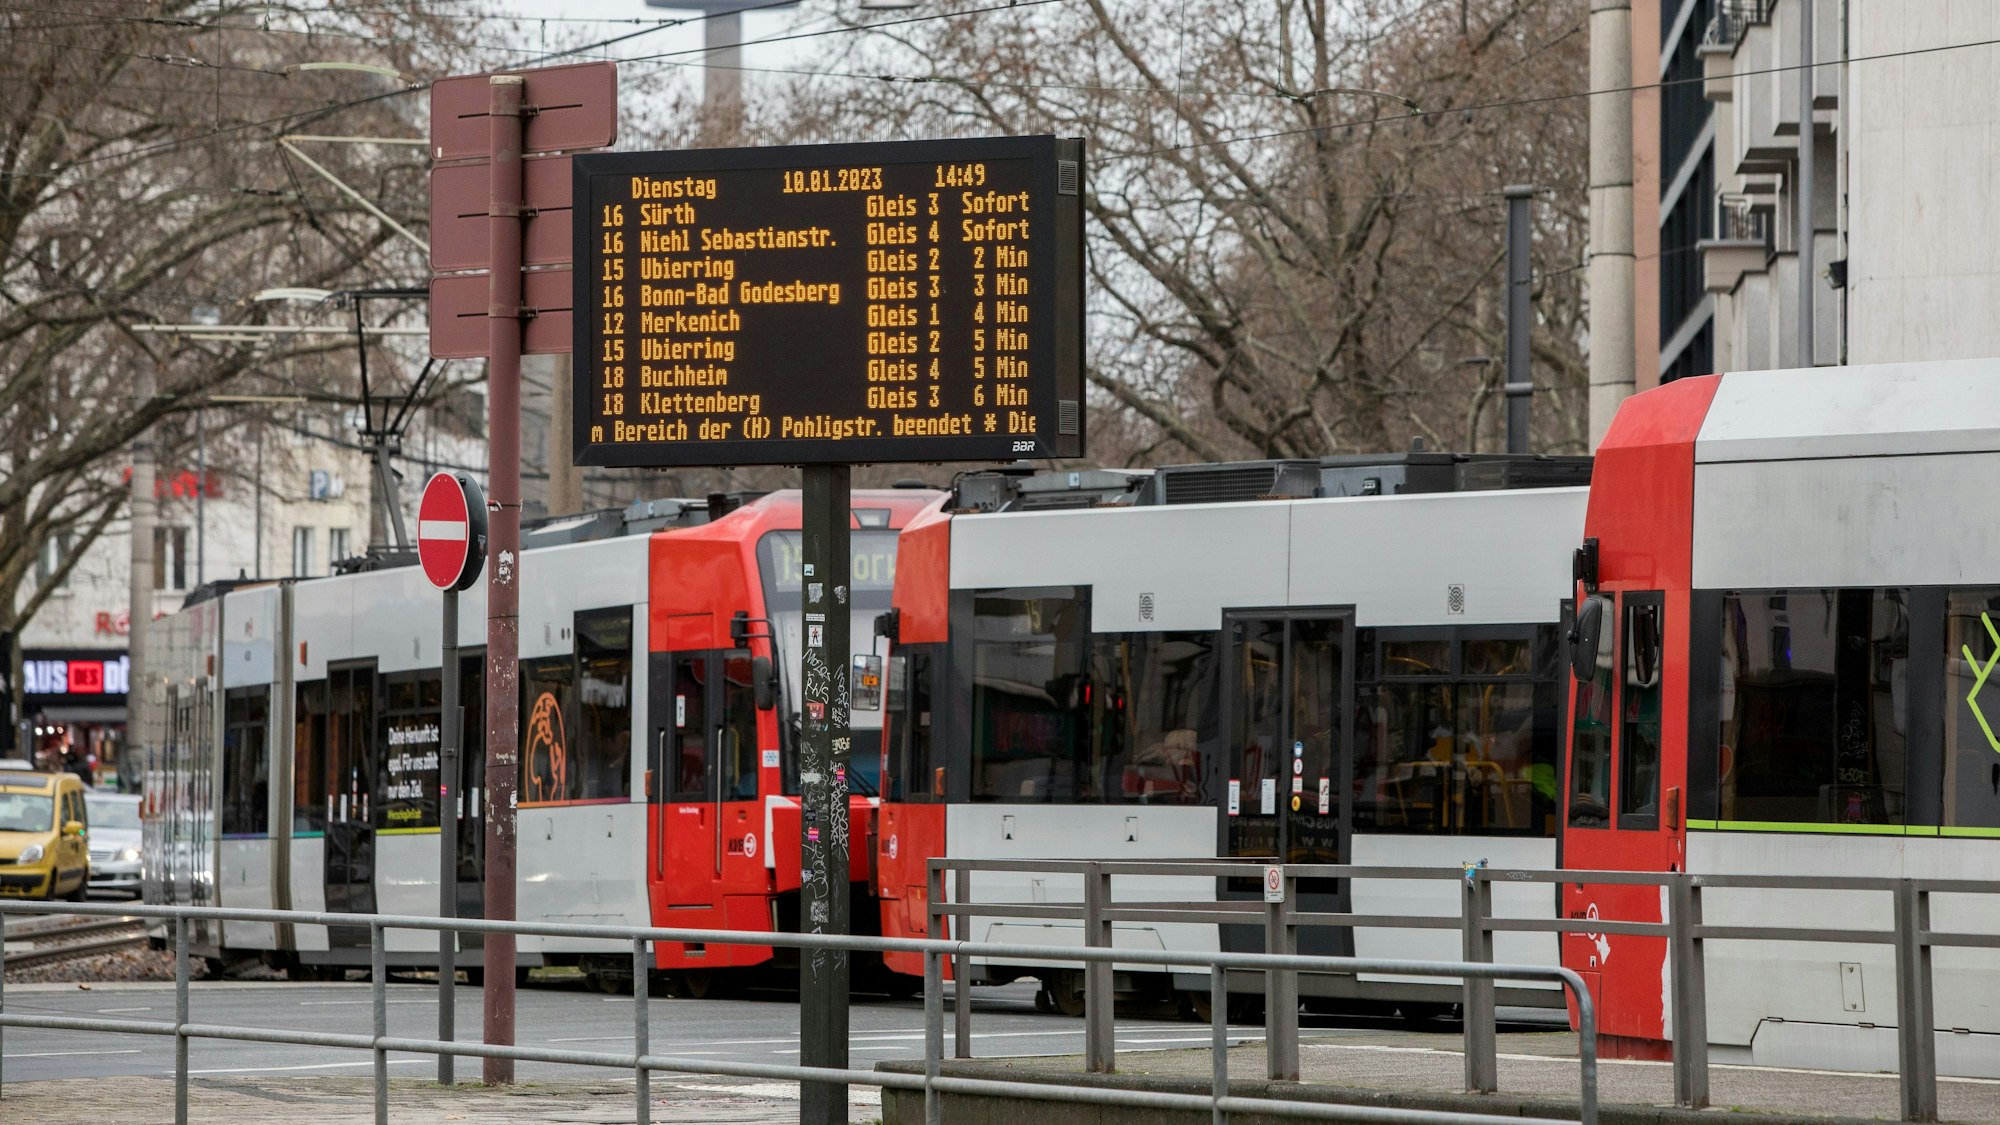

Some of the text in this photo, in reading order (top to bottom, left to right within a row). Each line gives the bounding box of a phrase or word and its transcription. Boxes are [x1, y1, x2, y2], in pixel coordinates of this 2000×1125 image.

[632, 164, 985, 199] Dienstag 10.01.2023 14:49
[603, 191, 1029, 226] 16 Sürth Gleis 3 Sofort
[603, 219, 1029, 253] 16 Niehl Sebastianstr. Gleis 4 Sofort
[603, 246, 1027, 281] 15 Ubierring Gleis 2 2 Min
[603, 273, 1027, 307] 16 Bonn-Bad Godesberg Gleis 3 3 Min
[603, 301, 1027, 334] 12 Merkenich Gleis 1 4 Min
[603, 329, 1027, 361] 15 Ubierring Gleis 2 5 Min
[603, 356, 1027, 388] 18 Buchheim Gleis 4 5 Min
[603, 384, 1027, 415] 18 Klettenberg Gleis 3 6 Min
[615, 419, 687, 441] Bereich
[699, 418, 731, 439] der
[743, 416, 770, 438] (H)
[782, 416, 882, 440] Pohligstr.
[894, 413, 971, 435] beendet
[1012, 441, 1036, 451] BBR
[23, 655, 130, 694] AUS DES DÖ
[388, 724, 440, 745] Deine Herkunft ist
[402, 752, 412, 772] Für
